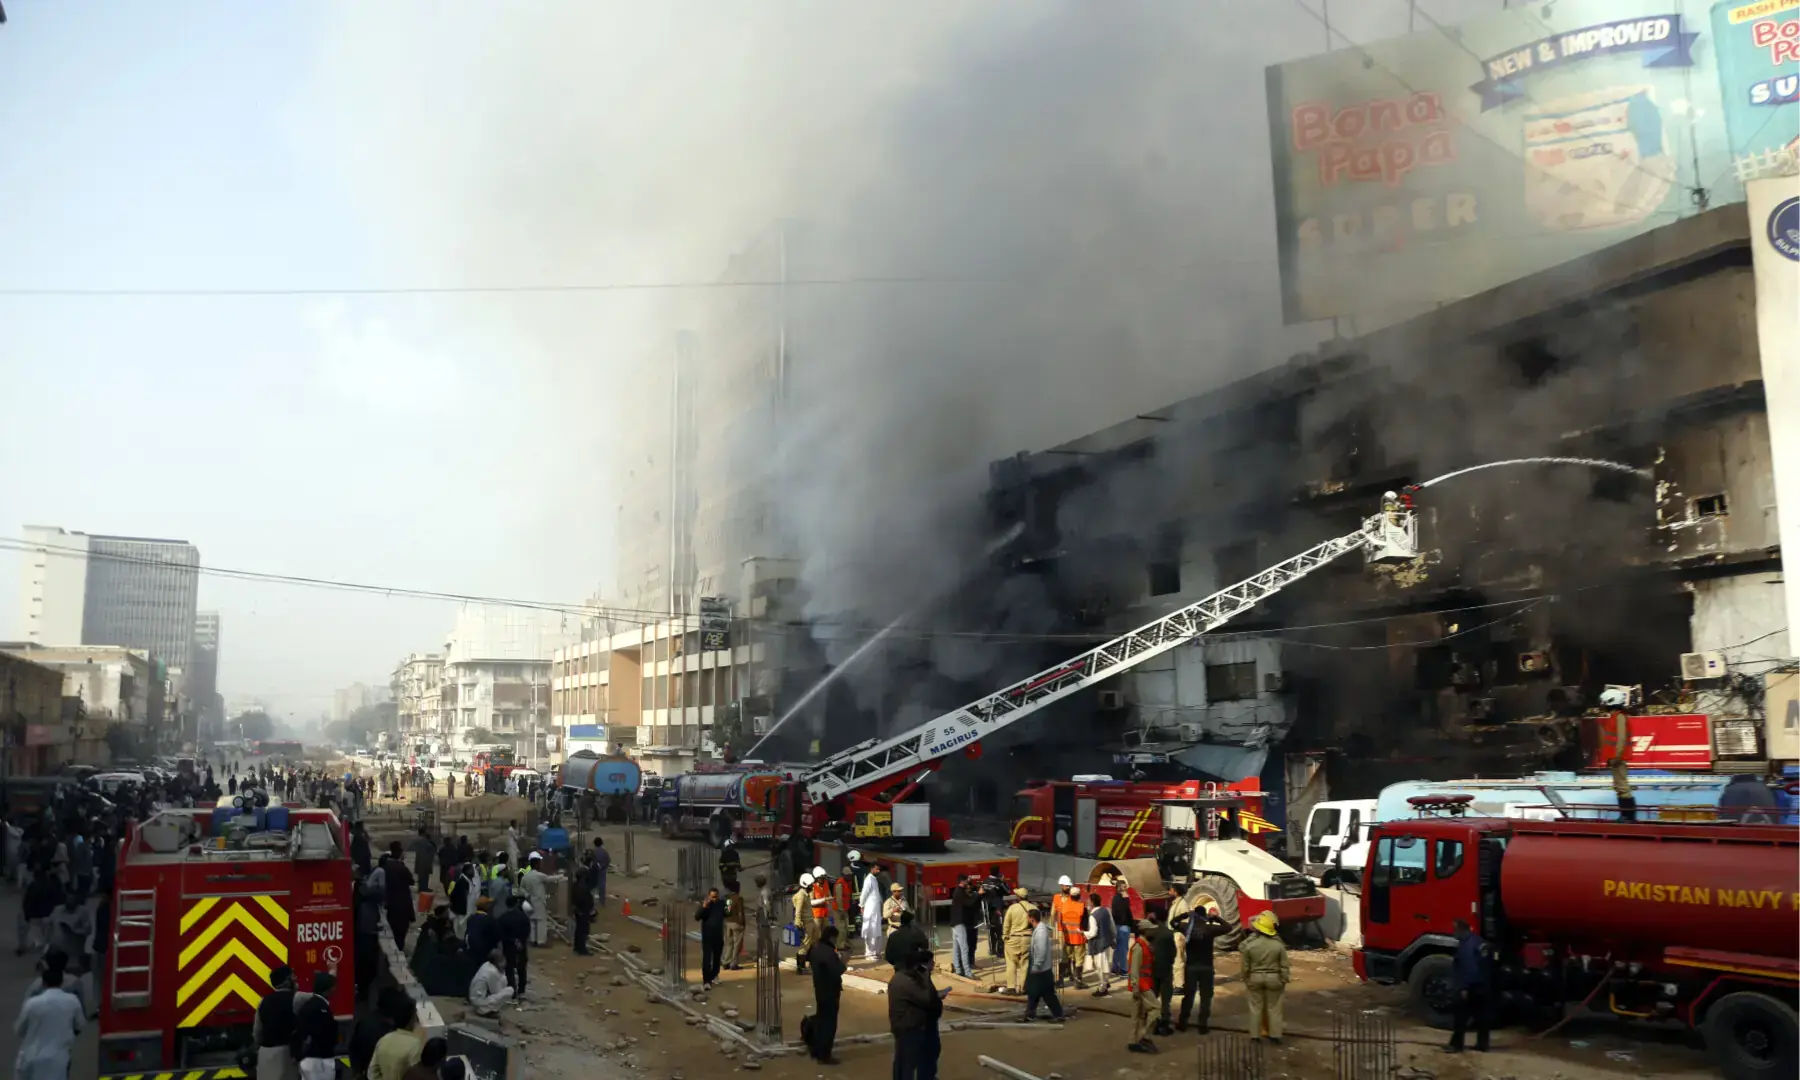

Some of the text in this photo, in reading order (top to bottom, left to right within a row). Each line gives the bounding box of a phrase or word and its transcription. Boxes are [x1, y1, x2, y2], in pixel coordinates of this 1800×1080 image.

[1736, 2, 1774, 20] RASH
[1489, 19, 1671, 80] NEW & IMPROVED
[1293, 92, 1443, 150] Bona
[1319, 130, 1453, 184] Papa
[1297, 194, 1477, 248] SUPER
[930, 729, 978, 755] MAGIRUS
[943, 726, 955, 736] 55
[1604, 879, 1710, 905] PAKISTAN
[1717, 888, 1783, 910] NAVY
[297, 921, 343, 942] RESCUE
[306, 948, 317, 964] 16
